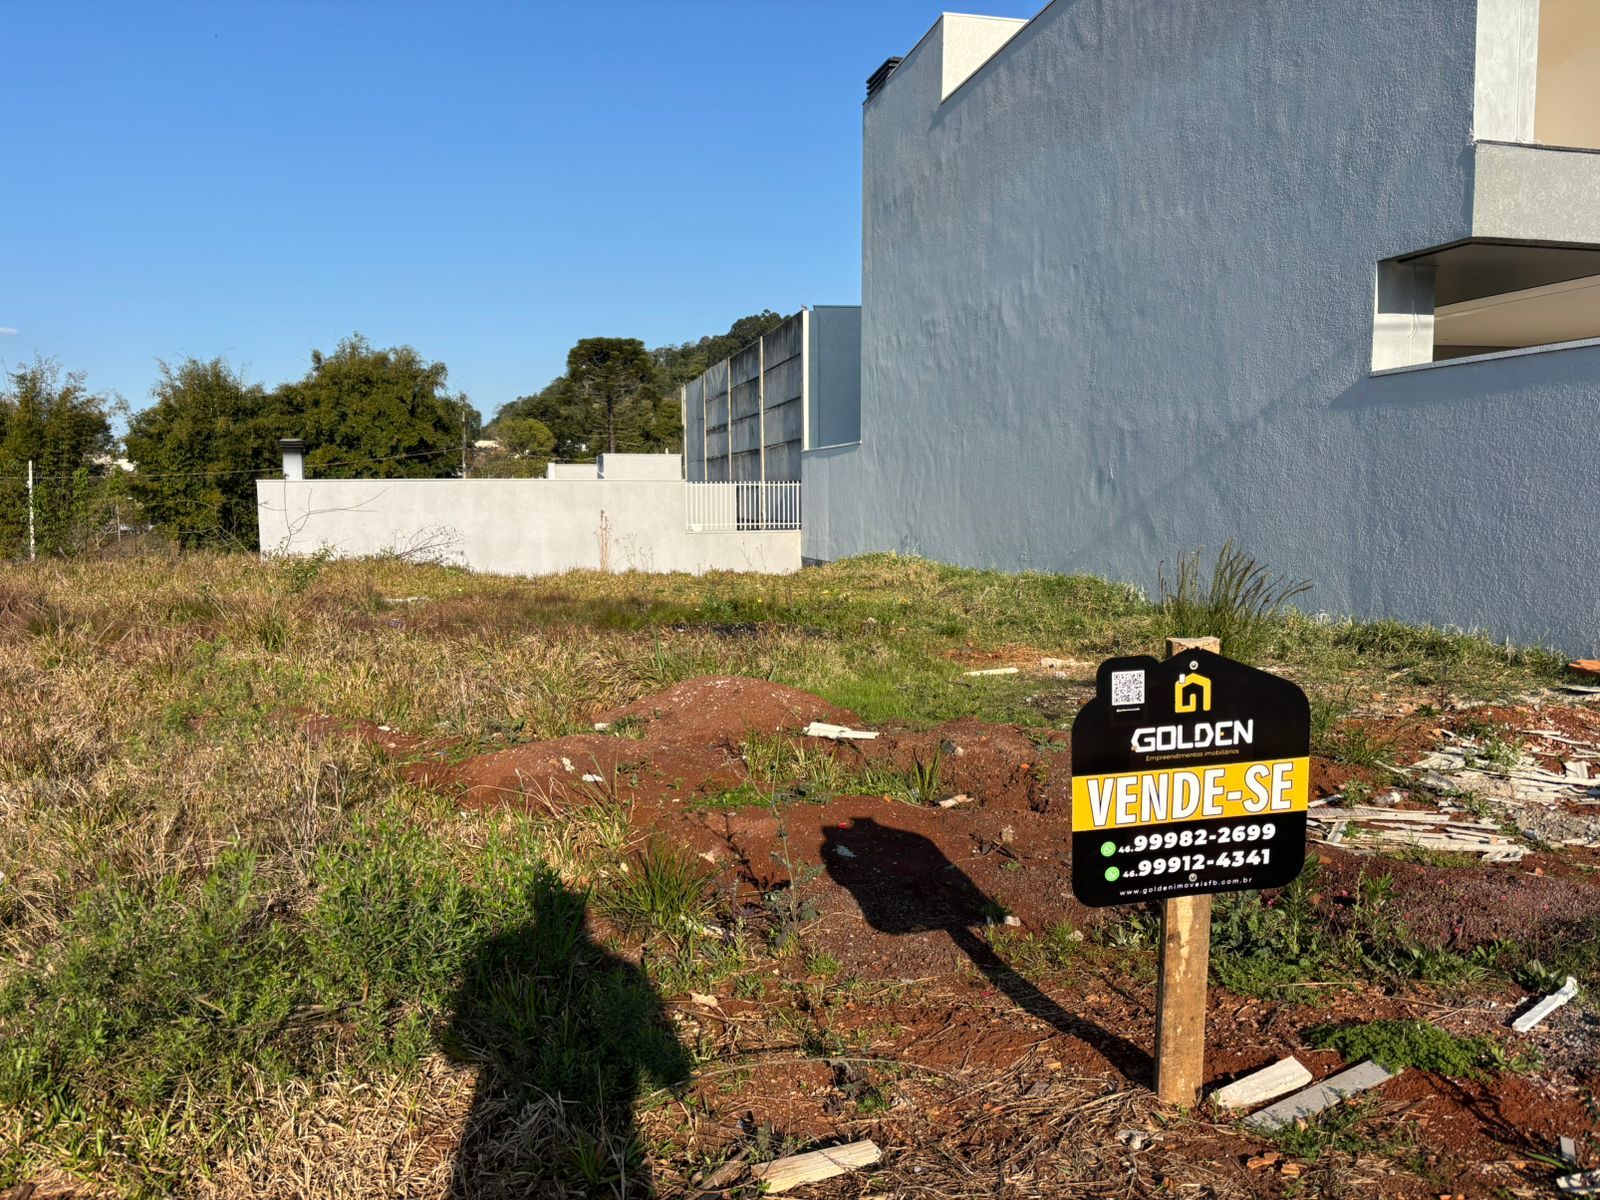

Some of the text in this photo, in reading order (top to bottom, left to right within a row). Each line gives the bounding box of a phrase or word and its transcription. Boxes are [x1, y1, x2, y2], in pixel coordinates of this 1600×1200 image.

[1131, 719, 1253, 753] GOLDEN
[1145, 751, 1203, 762] Empreendimentos
[1087, 762, 1293, 827] VENDE-SE
[1119, 877, 1252, 896] www.goldenimoveisfb.com.br
